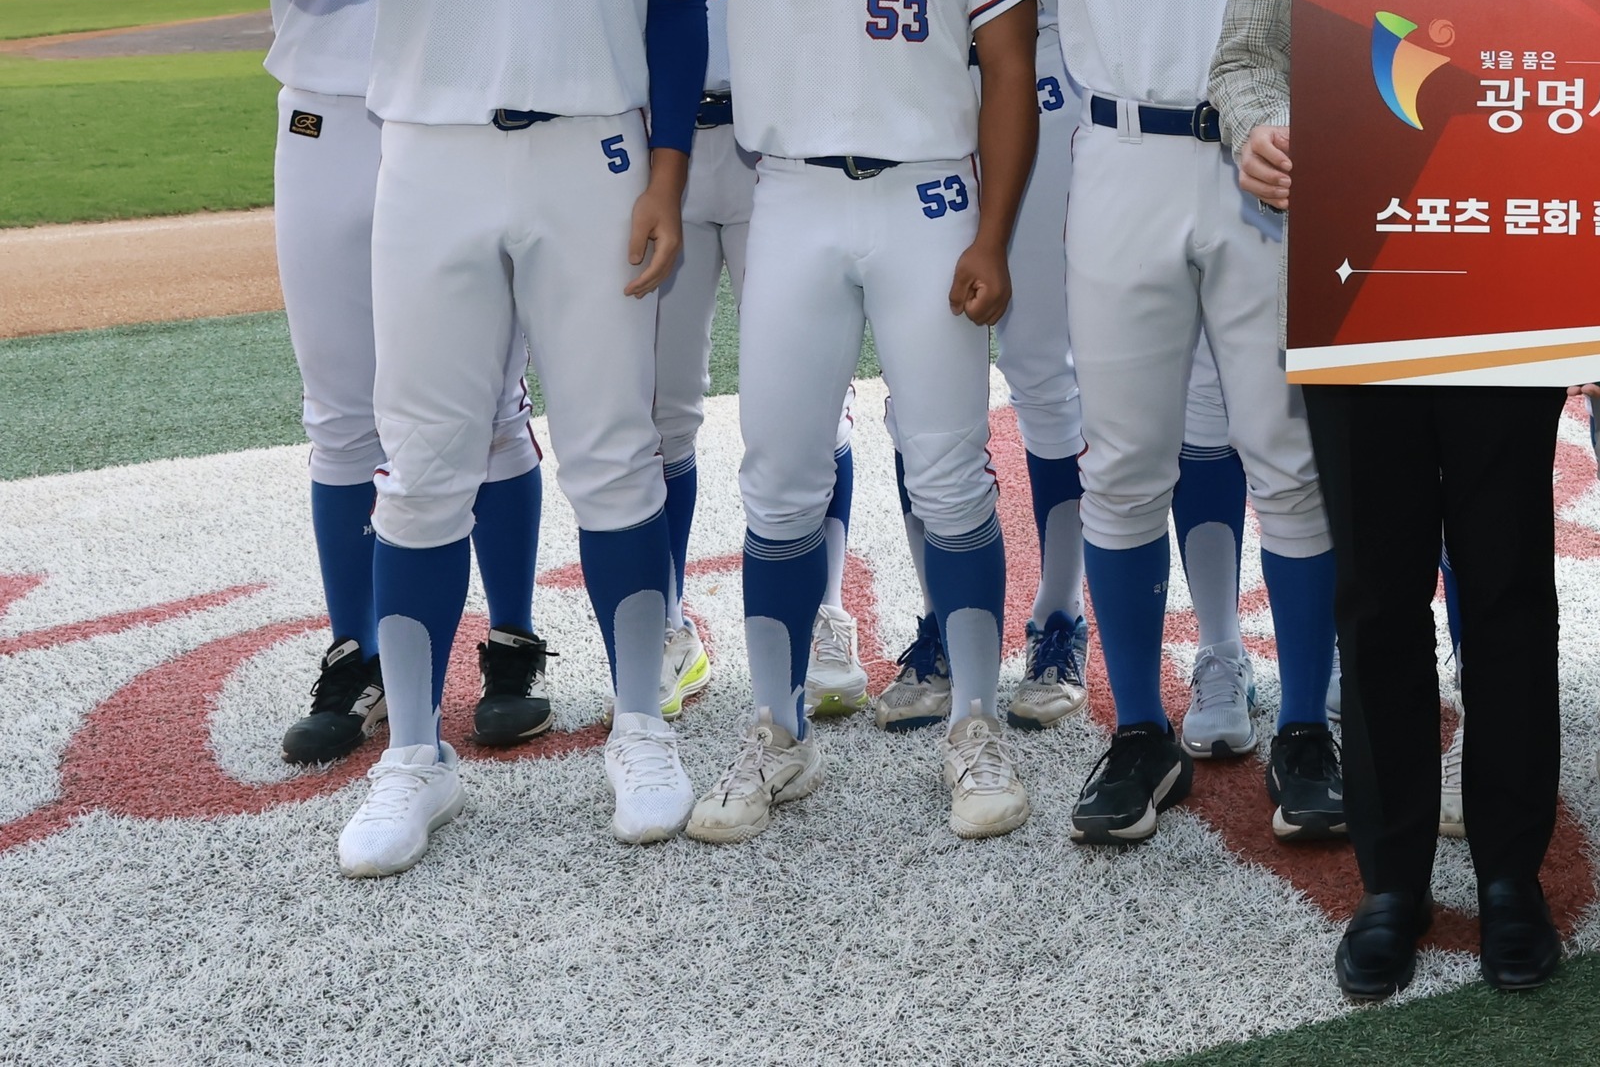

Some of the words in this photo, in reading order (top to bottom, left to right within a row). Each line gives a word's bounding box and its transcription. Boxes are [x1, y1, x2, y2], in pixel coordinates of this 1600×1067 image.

[1480, 50, 1515, 70] 빛을
[1522, 51, 1557, 71] 품은
[1037, 76, 1064, 114] 3
[601, 134, 630, 174] 5
[916, 175, 969, 220] 53
[1375, 197, 1491, 234] 스포츠
[1503, 198, 1581, 236] 문화
